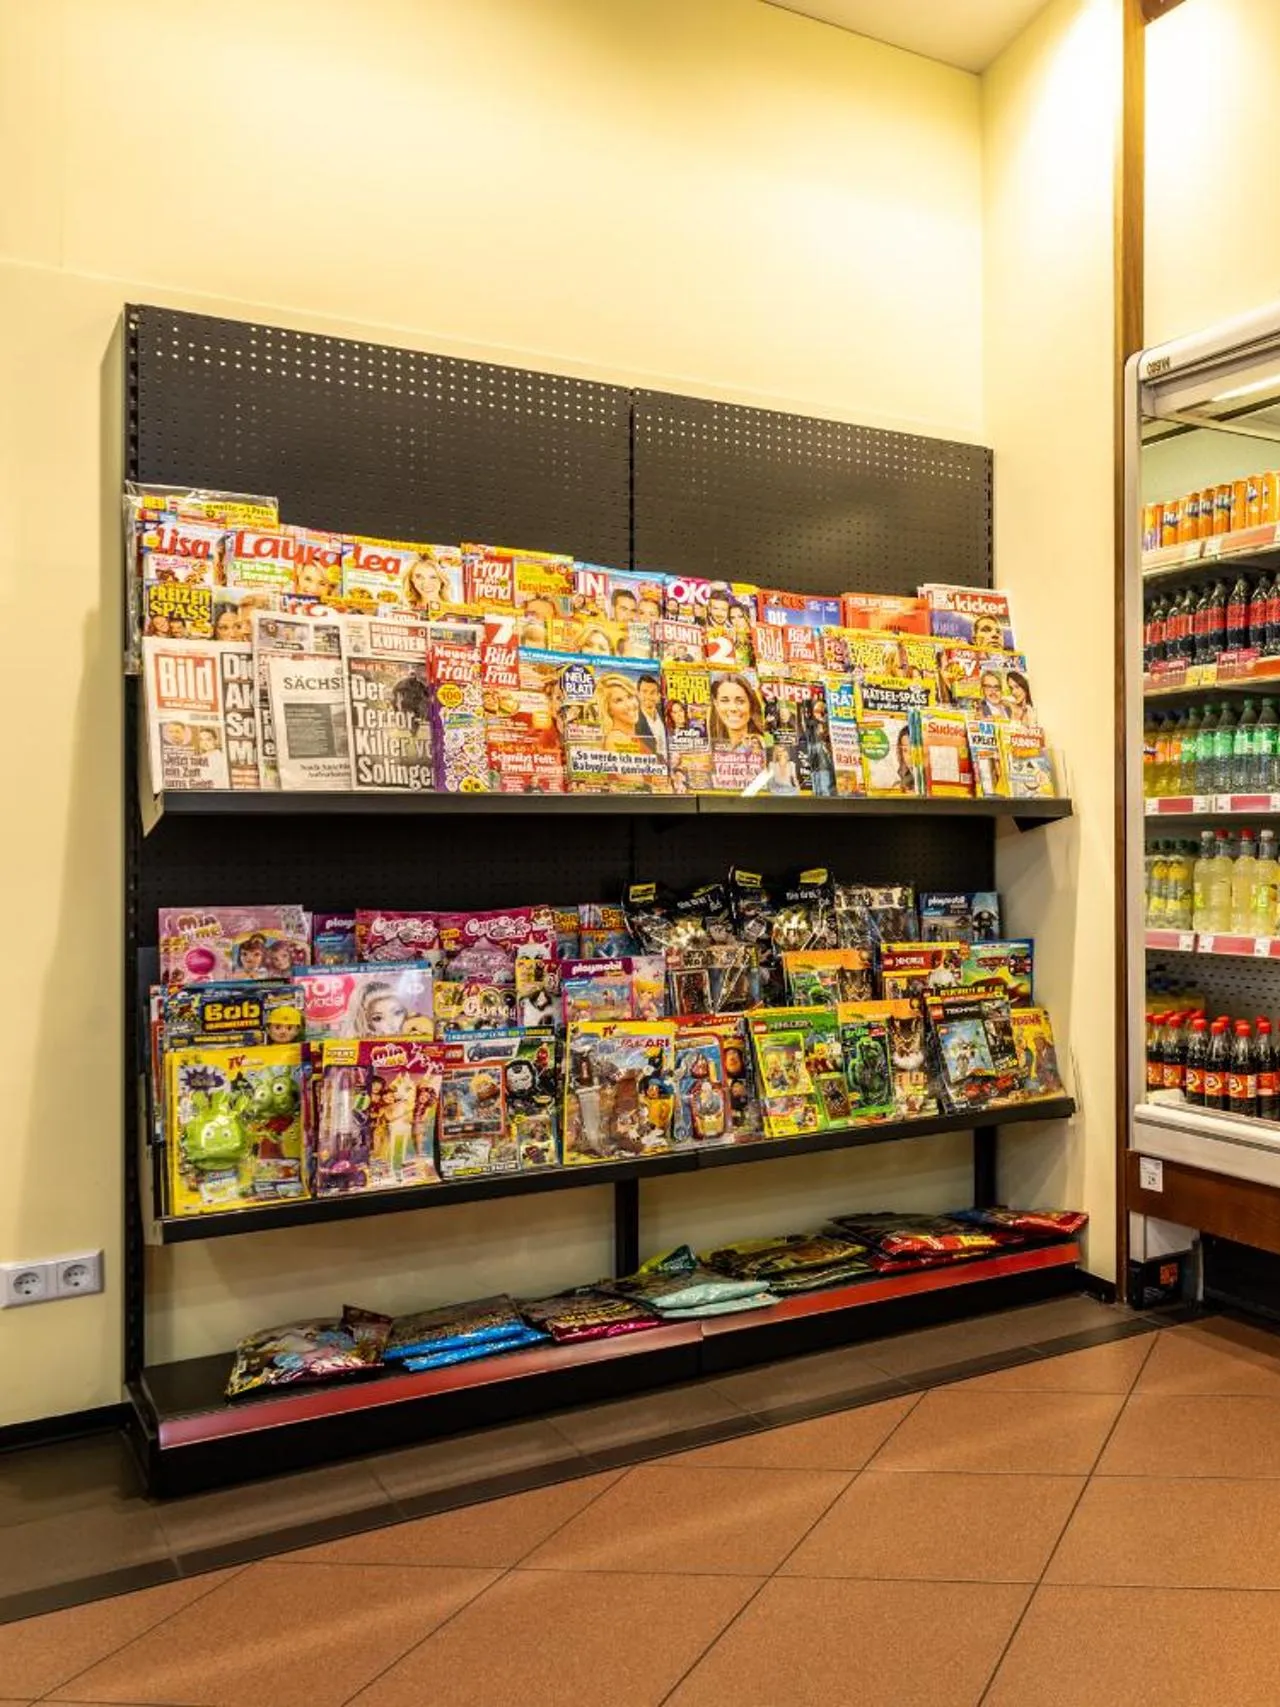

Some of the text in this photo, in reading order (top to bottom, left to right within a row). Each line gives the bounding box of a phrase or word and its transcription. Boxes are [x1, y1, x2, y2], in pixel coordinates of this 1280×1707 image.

[156, 527, 211, 560] Lisa
[234, 530, 342, 568] Laura
[355, 545, 402, 575] Lea
[472, 560, 511, 579] Frau
[473, 582, 513, 601] Trend
[578, 571, 608, 594] IN
[667, 580, 711, 605] OK!
[149, 602, 211, 622] SPASS
[956, 594, 1007, 615] kicker
[484, 646, 517, 666] Bild
[157, 655, 215, 702] Bild
[484, 667, 518, 687] Frau
[564, 672, 593, 685] NEUE
[351, 674, 386, 701] Der
[565, 683, 594, 696] BLATT
[761, 684, 811, 702] SUPER
[354, 728, 409, 755] Killer
[571, 960, 623, 976] playmobil
[301, 978, 345, 998] TOP
[203, 1001, 261, 1022] Bob
